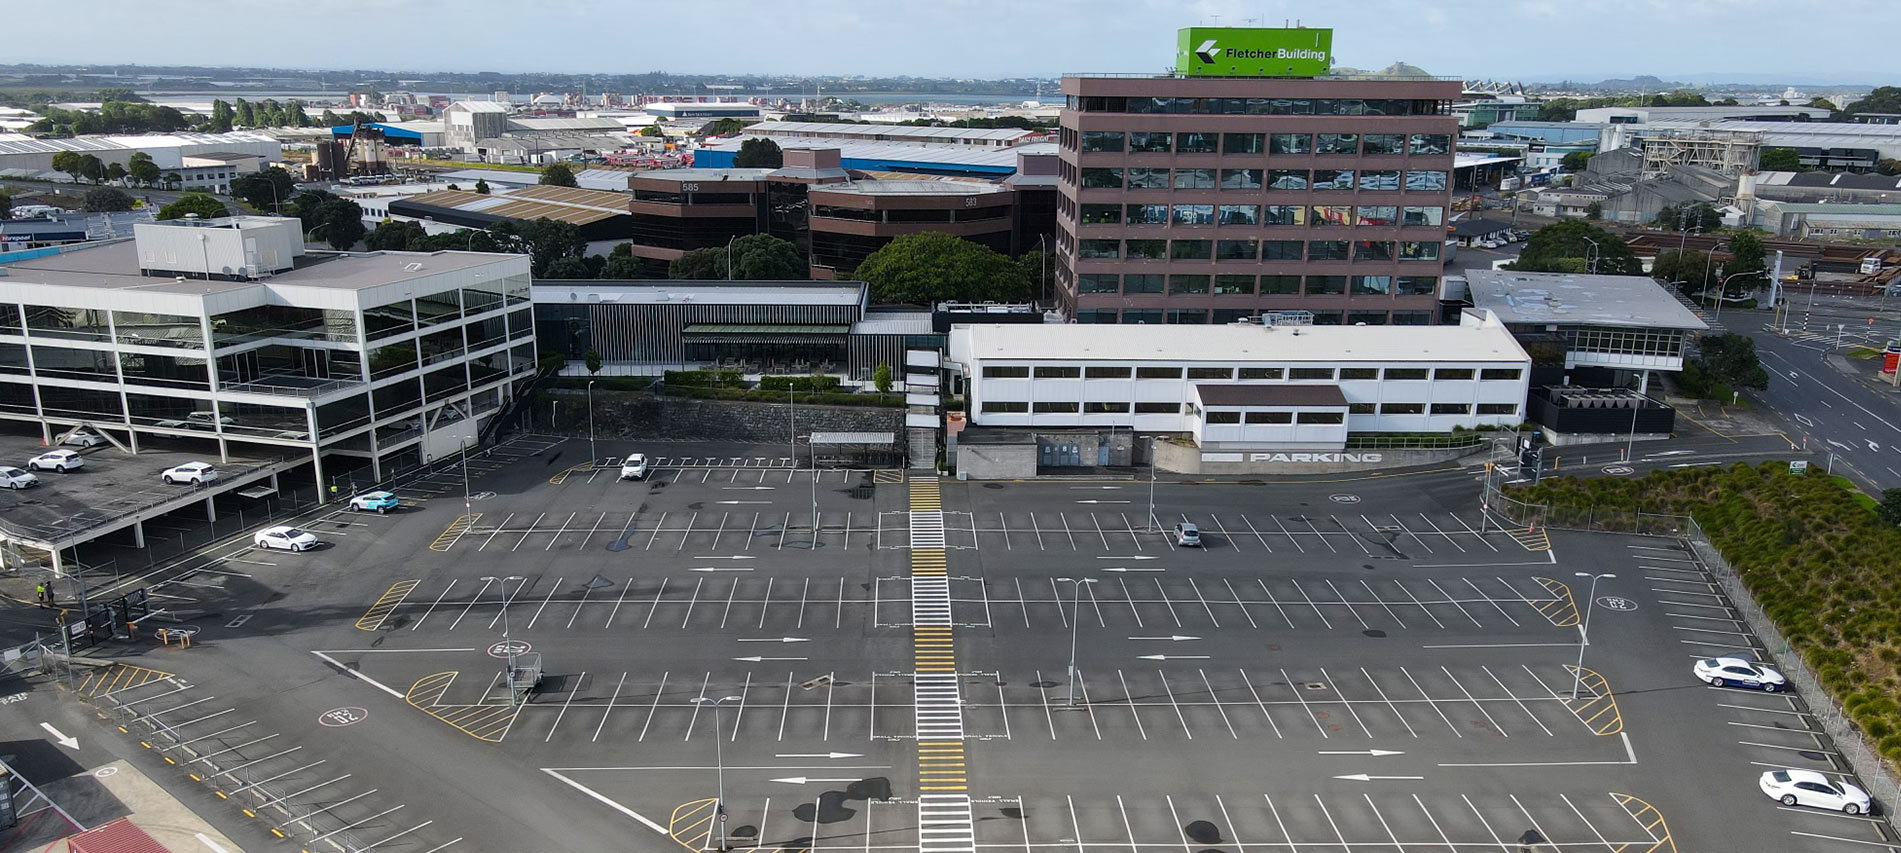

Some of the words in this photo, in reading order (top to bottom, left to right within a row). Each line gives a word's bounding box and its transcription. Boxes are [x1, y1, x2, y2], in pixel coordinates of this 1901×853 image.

[1226, 48, 1326, 62] FletcherBuilding
[682, 183, 699, 191] 585
[965, 198, 977, 206] 583
[1250, 453, 1383, 463] PARKING
